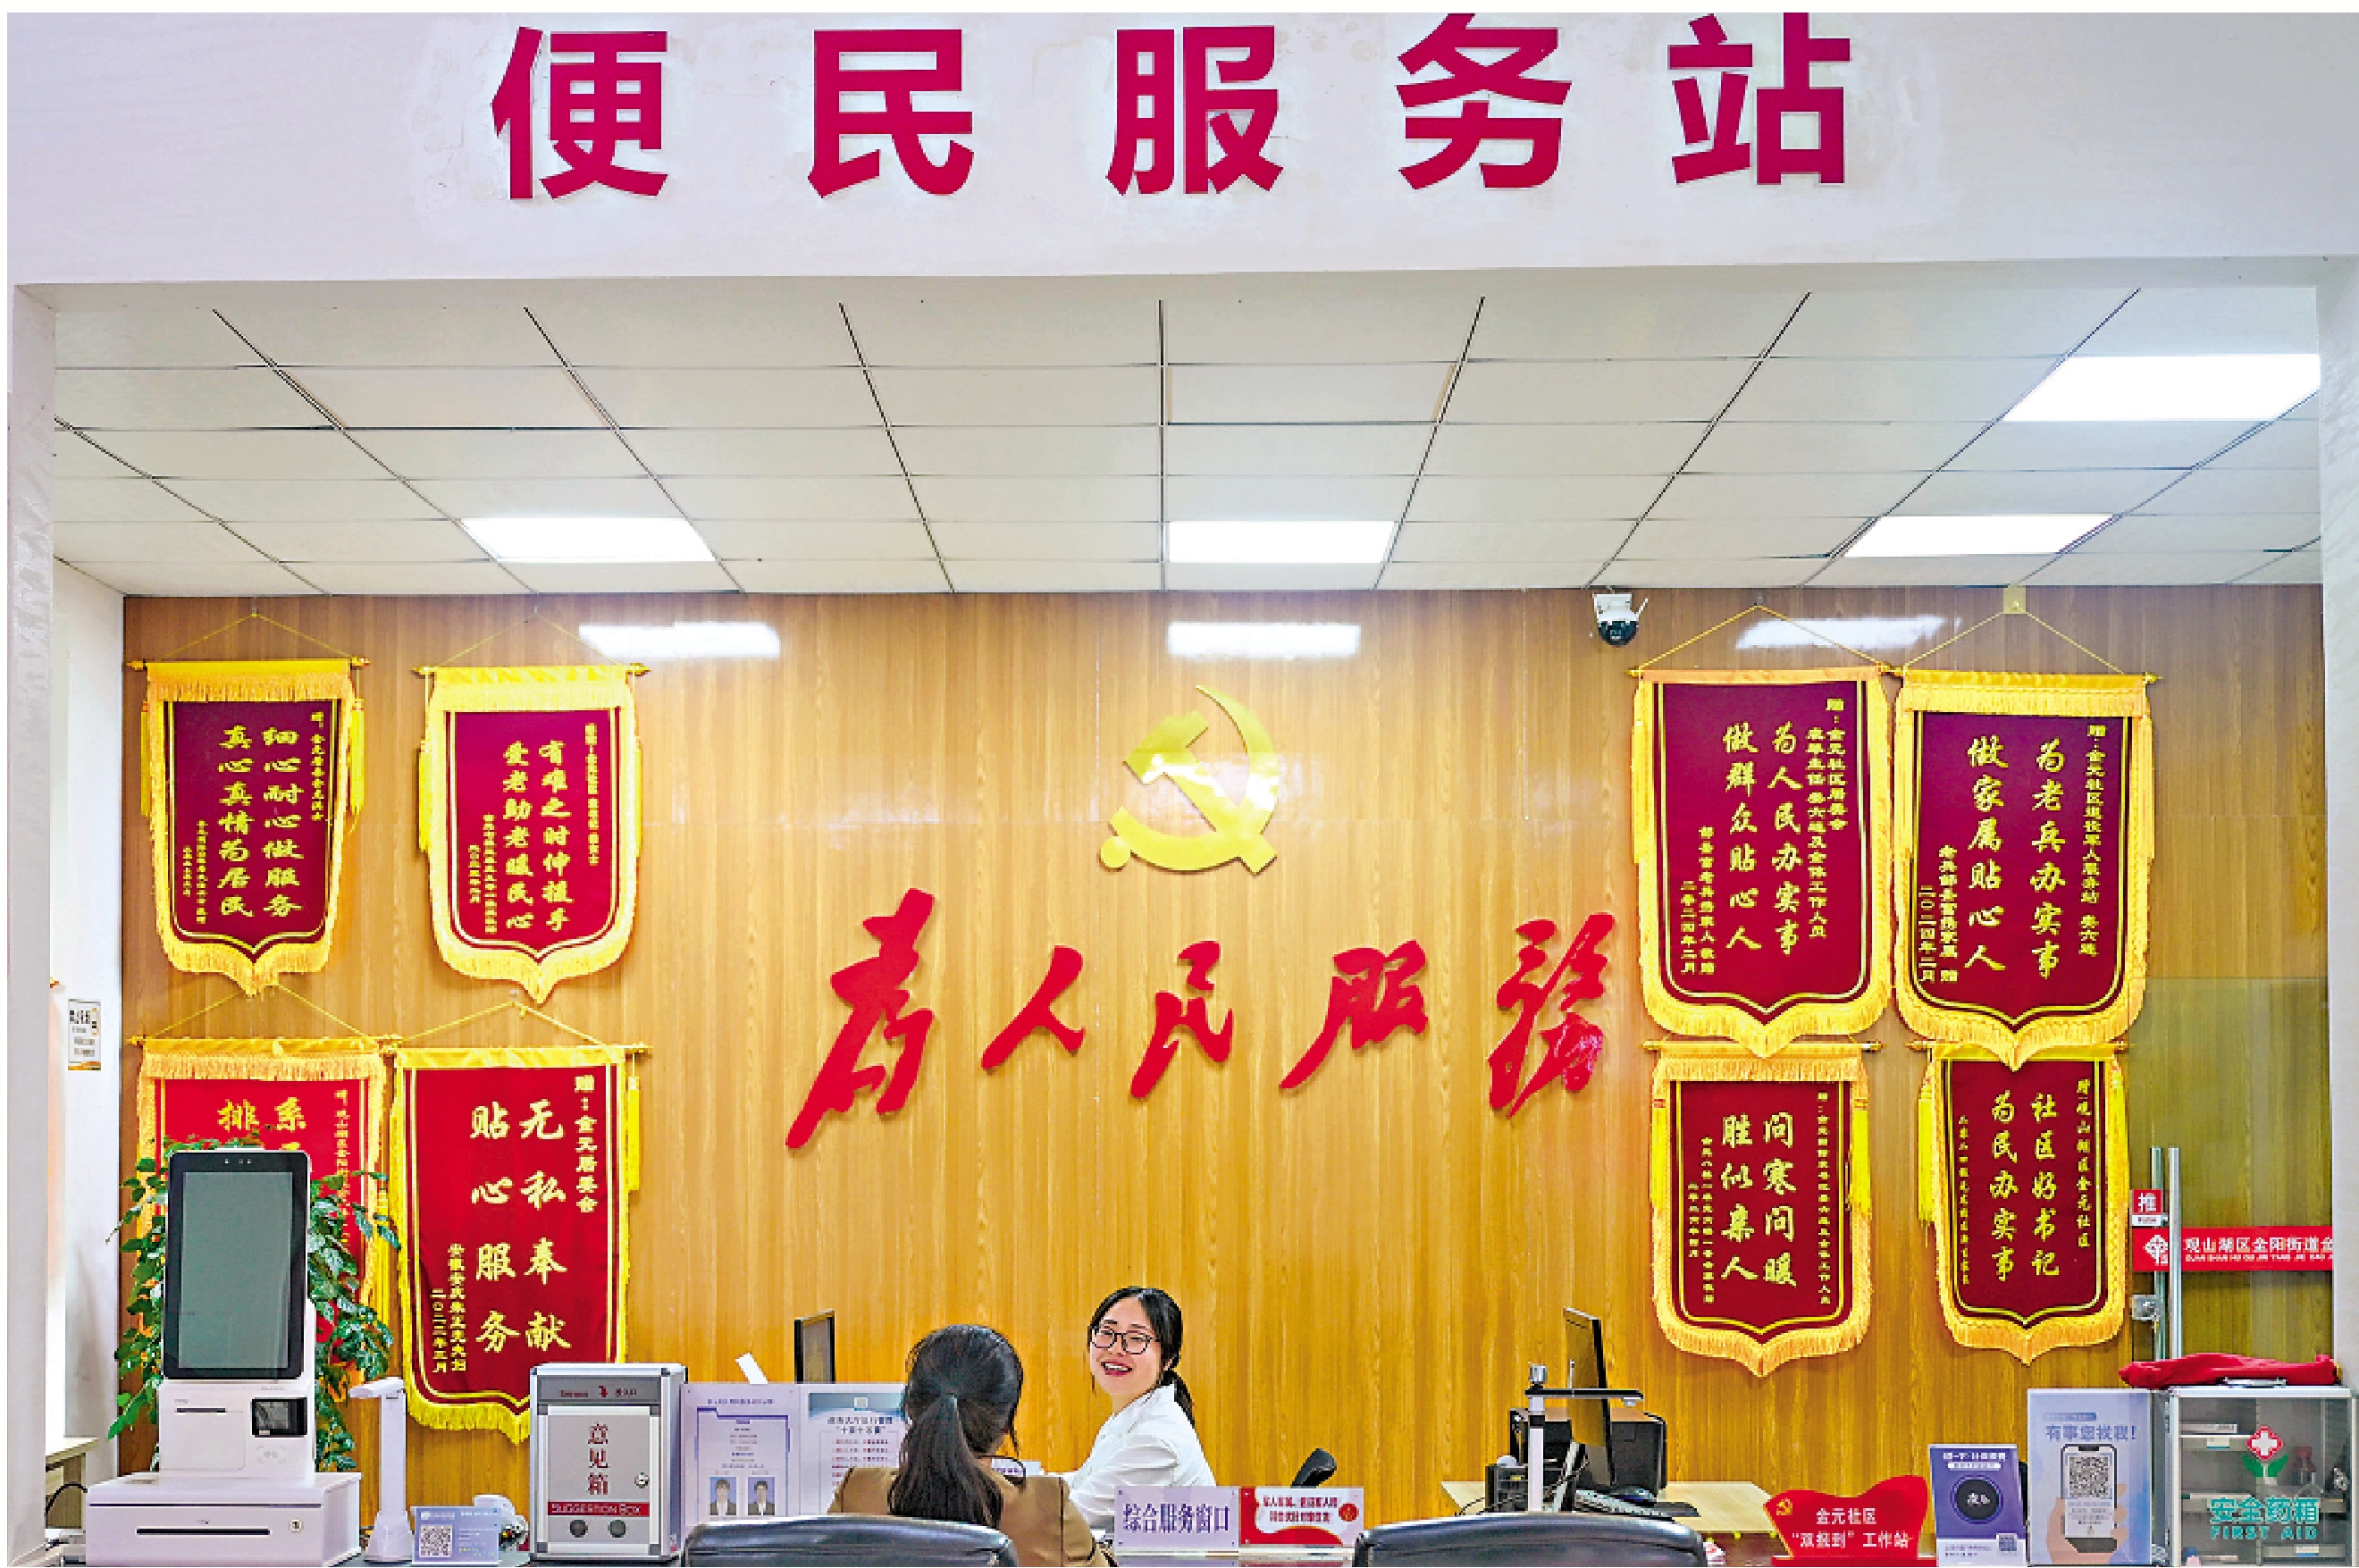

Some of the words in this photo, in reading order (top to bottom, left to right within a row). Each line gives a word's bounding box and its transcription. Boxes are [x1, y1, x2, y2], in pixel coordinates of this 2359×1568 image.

[492, 13, 1850, 198] 便民服务站
[217, 725, 255, 917] 真心真情为居民
[1723, 722, 1761, 950] 做群众贴心人
[1767, 722, 1803, 954] 为人民办实事
[1965, 734, 2008, 970] 做家属贴心人
[2030, 739, 2065, 979] 为老兵办实事
[470, 1102, 520, 1353] 贴心服务
[516, 1099, 570, 1351] 无私奉献
[1721, 1114, 1759, 1279] 胜似亲人
[1763, 1112, 1796, 1287] 问寒问暖
[1990, 1090, 2019, 1281] 为民办实事
[2031, 1093, 2059, 1275] 社区好书记
[2137, 1192, 2157, 1212] 推
[1123, 1504, 1230, 1533] 综合服务窗口
[1817, 1508, 1876, 1524] 金元社区
[2211, 1525, 2270, 1539] FIRST
[2280, 1525, 2318, 1539] AID
